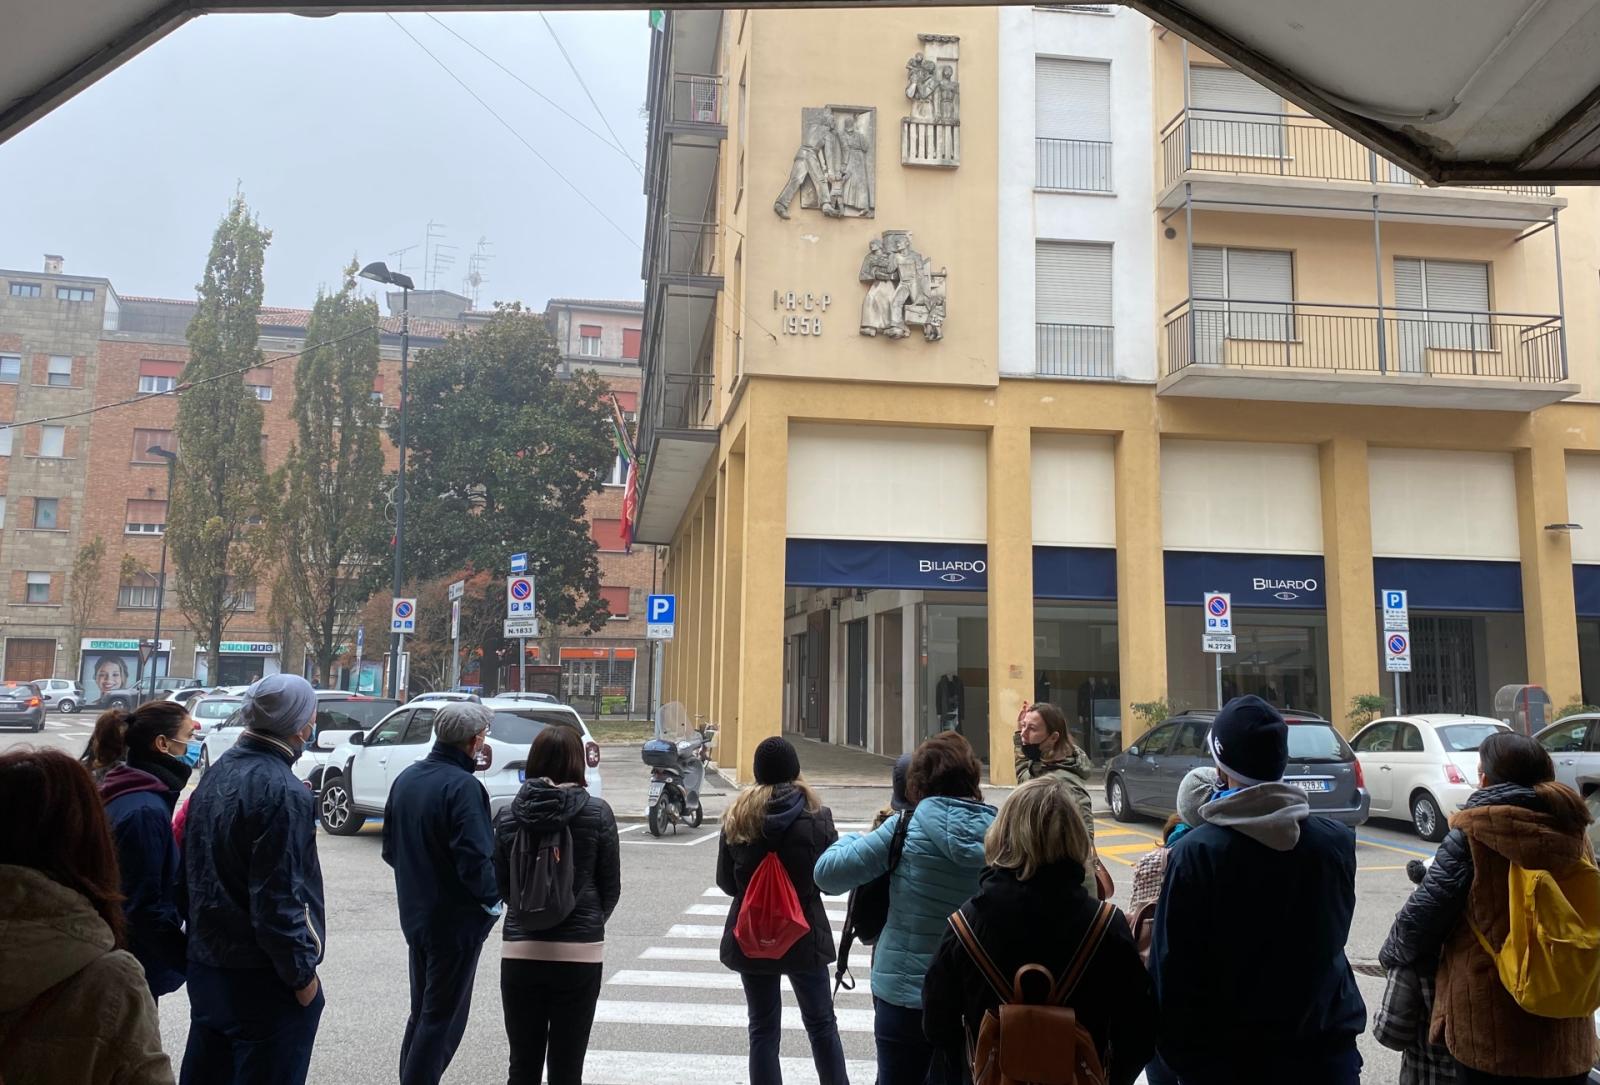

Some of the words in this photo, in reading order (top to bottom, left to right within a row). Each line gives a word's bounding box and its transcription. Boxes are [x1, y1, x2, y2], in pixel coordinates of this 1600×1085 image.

[782, 315, 822, 337] 1958
[919, 559, 986, 573] BILIARDO
[1253, 577, 1317, 591] BILIARDO
[512, 603, 518, 611] P
[1390, 593, 1400, 607] P
[653, 598, 670, 620] P
